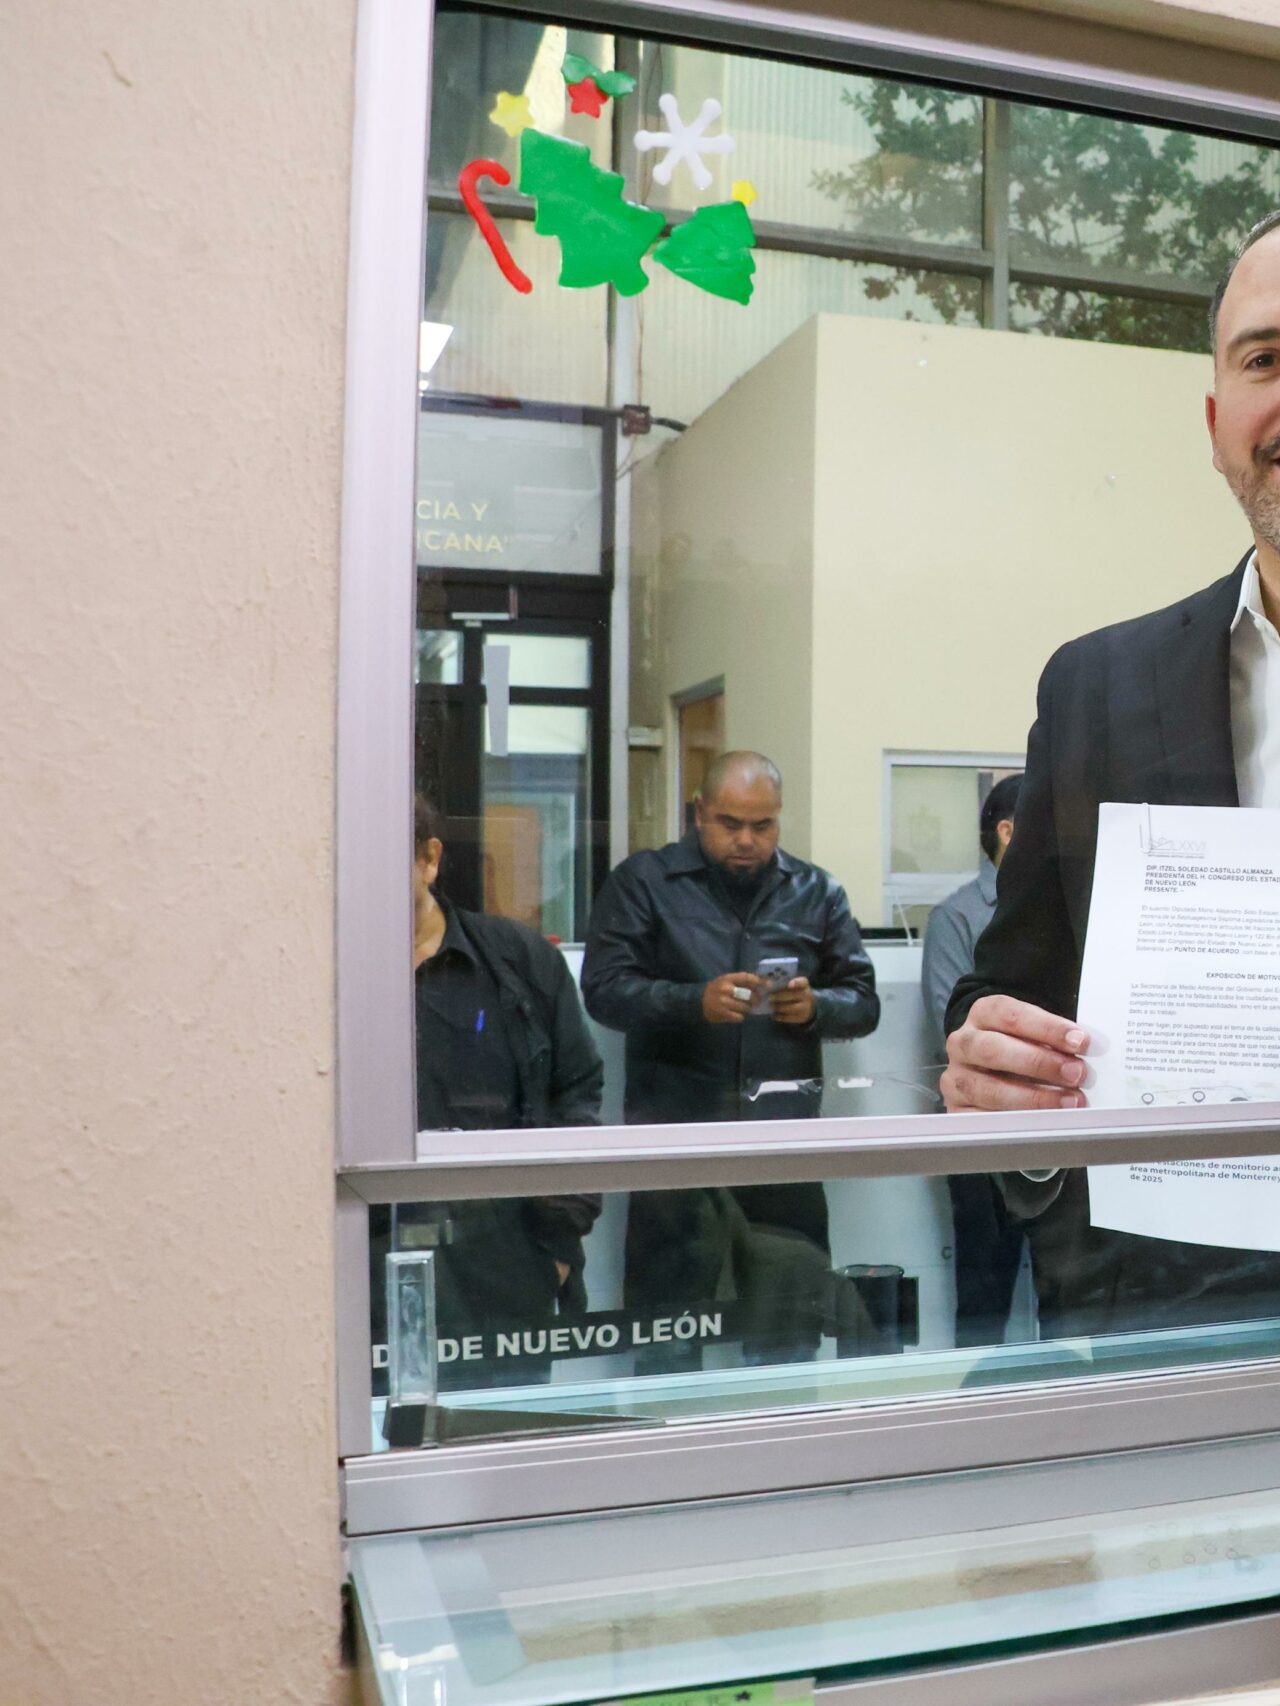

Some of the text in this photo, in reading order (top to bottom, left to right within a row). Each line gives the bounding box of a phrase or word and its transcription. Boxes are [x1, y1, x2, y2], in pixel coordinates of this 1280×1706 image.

[471, 502, 488, 521] Y
[1145, 871, 1184, 879] PRESIDENTA
[1207, 873, 1245, 881] CONGRESO
[1150, 1166, 1216, 1178] metropolitana
[438, 1336, 483, 1362] DE
[496, 1324, 620, 1356] NUEVO
[632, 1310, 722, 1344] LEÓN
